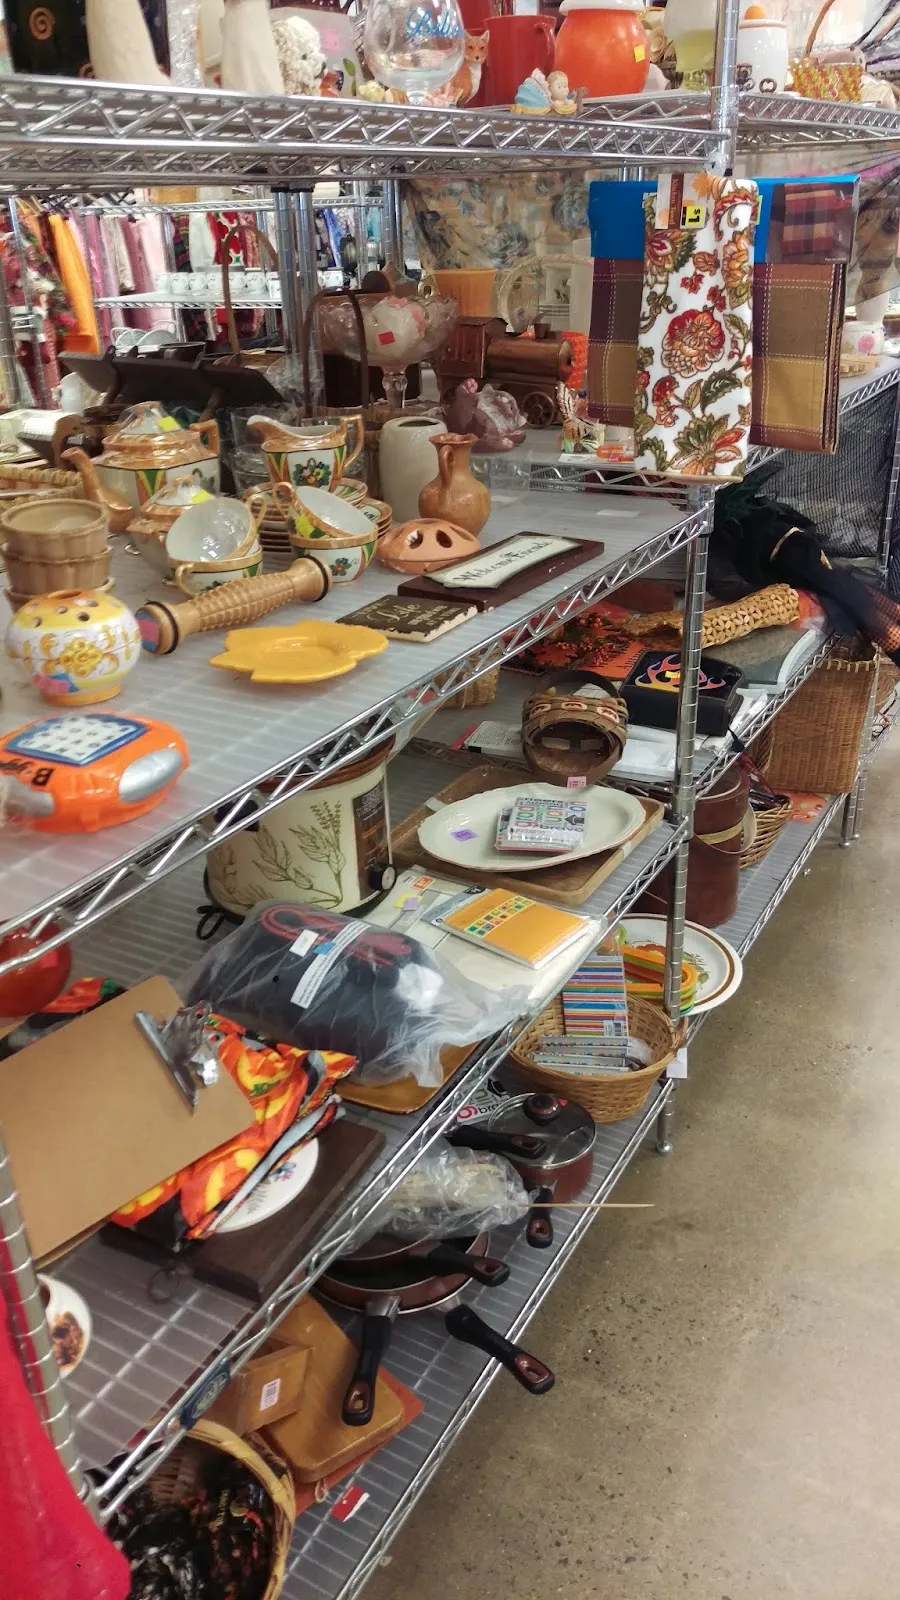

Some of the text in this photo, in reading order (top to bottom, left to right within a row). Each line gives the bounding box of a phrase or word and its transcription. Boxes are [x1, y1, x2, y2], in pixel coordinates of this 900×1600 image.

[669, 178, 679, 225] Kitchen Towel
[688, 208, 701, 223] $1
